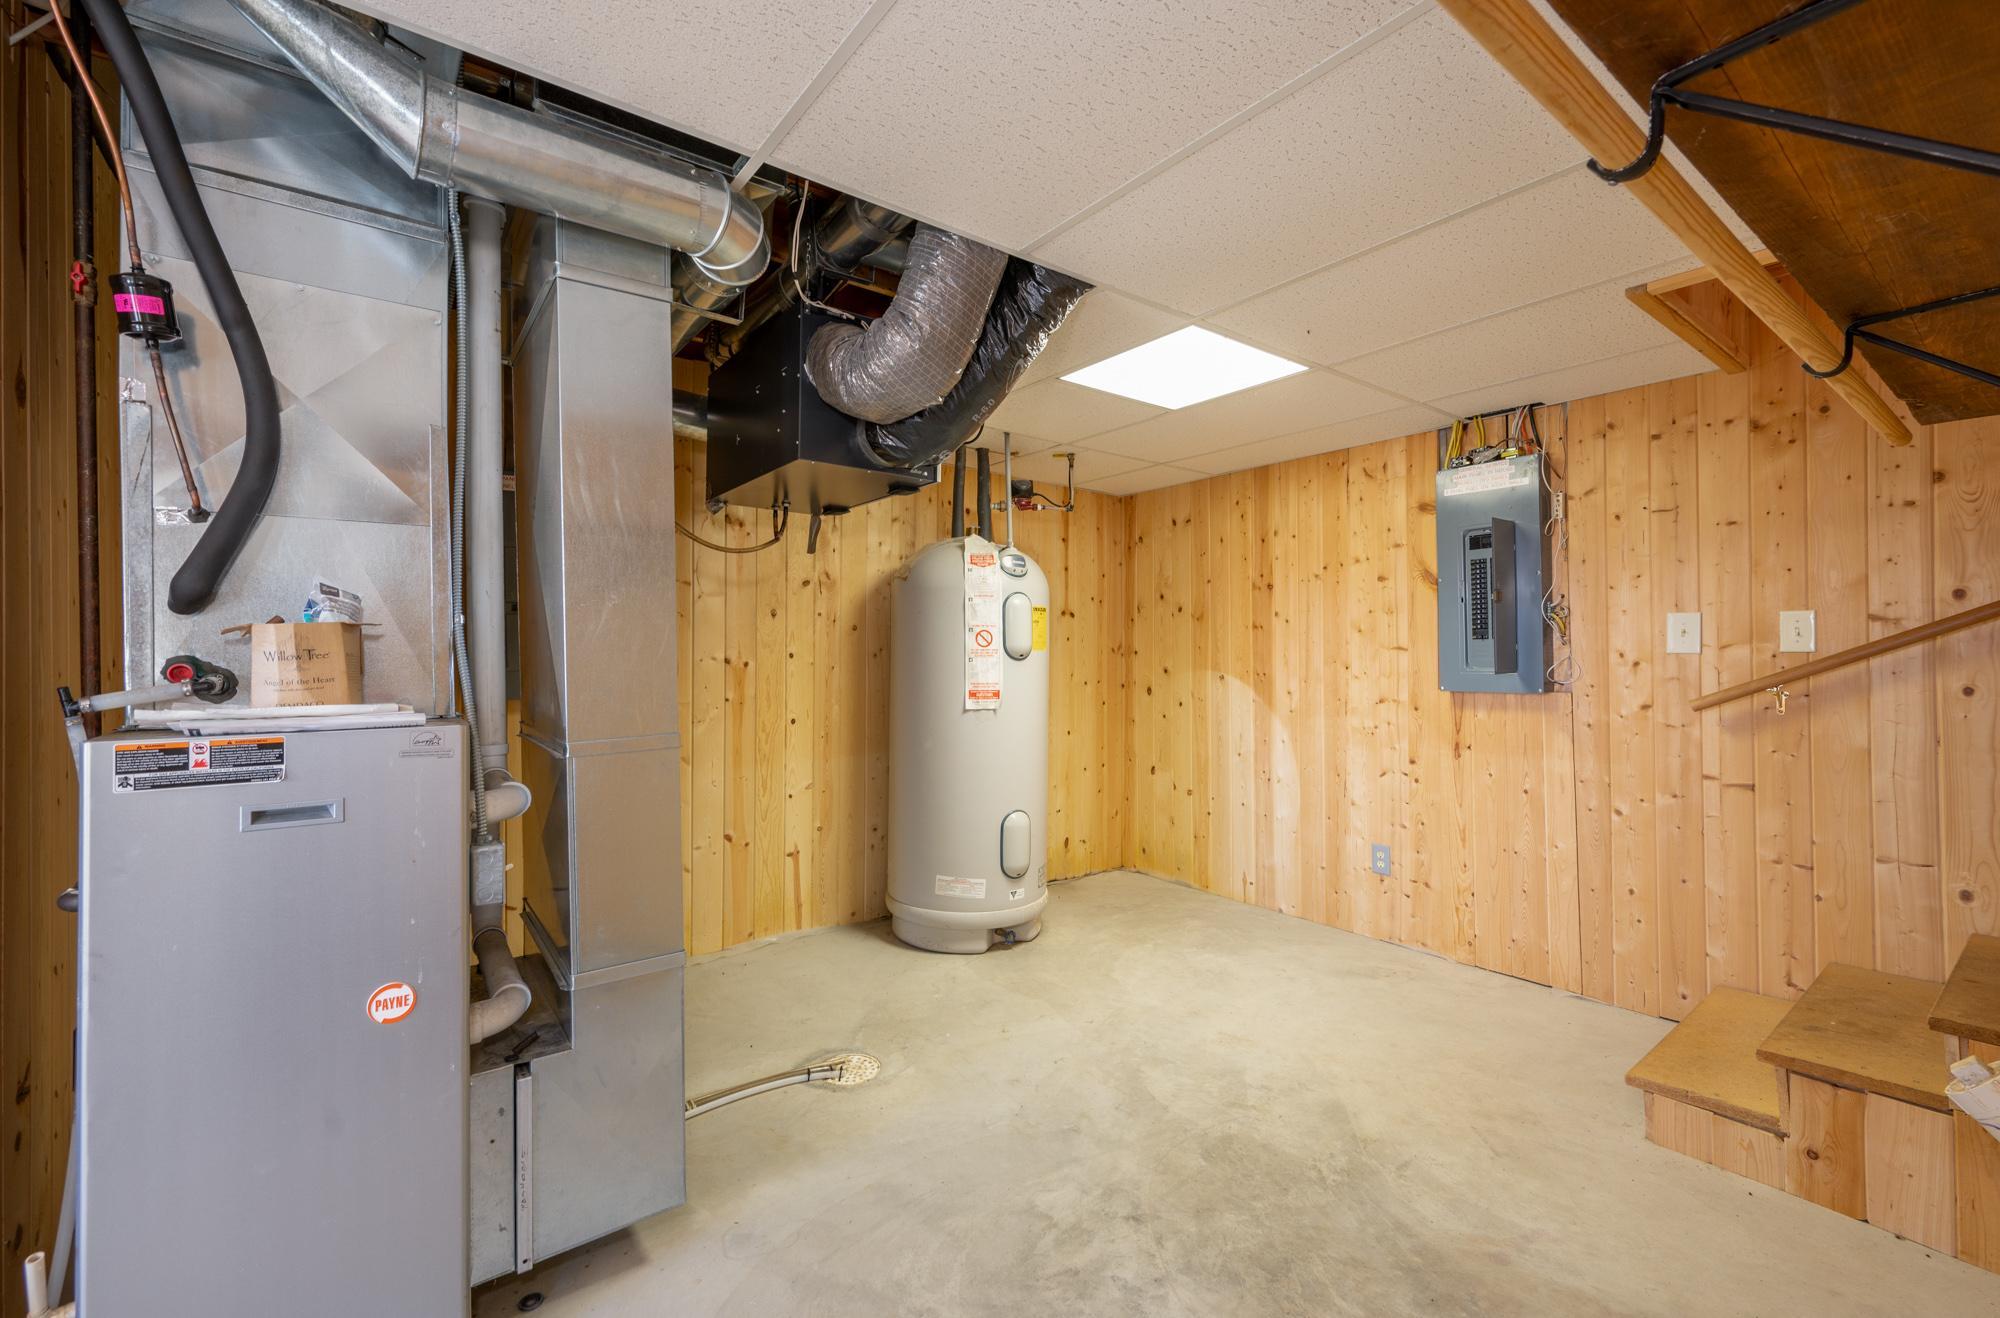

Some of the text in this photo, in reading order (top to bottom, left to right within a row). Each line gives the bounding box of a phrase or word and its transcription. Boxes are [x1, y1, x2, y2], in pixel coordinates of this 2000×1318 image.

[263, 648, 330, 662] Willow Tree
[312, 676, 335, 684] Heart
[375, 994, 410, 1012] PAYNE
